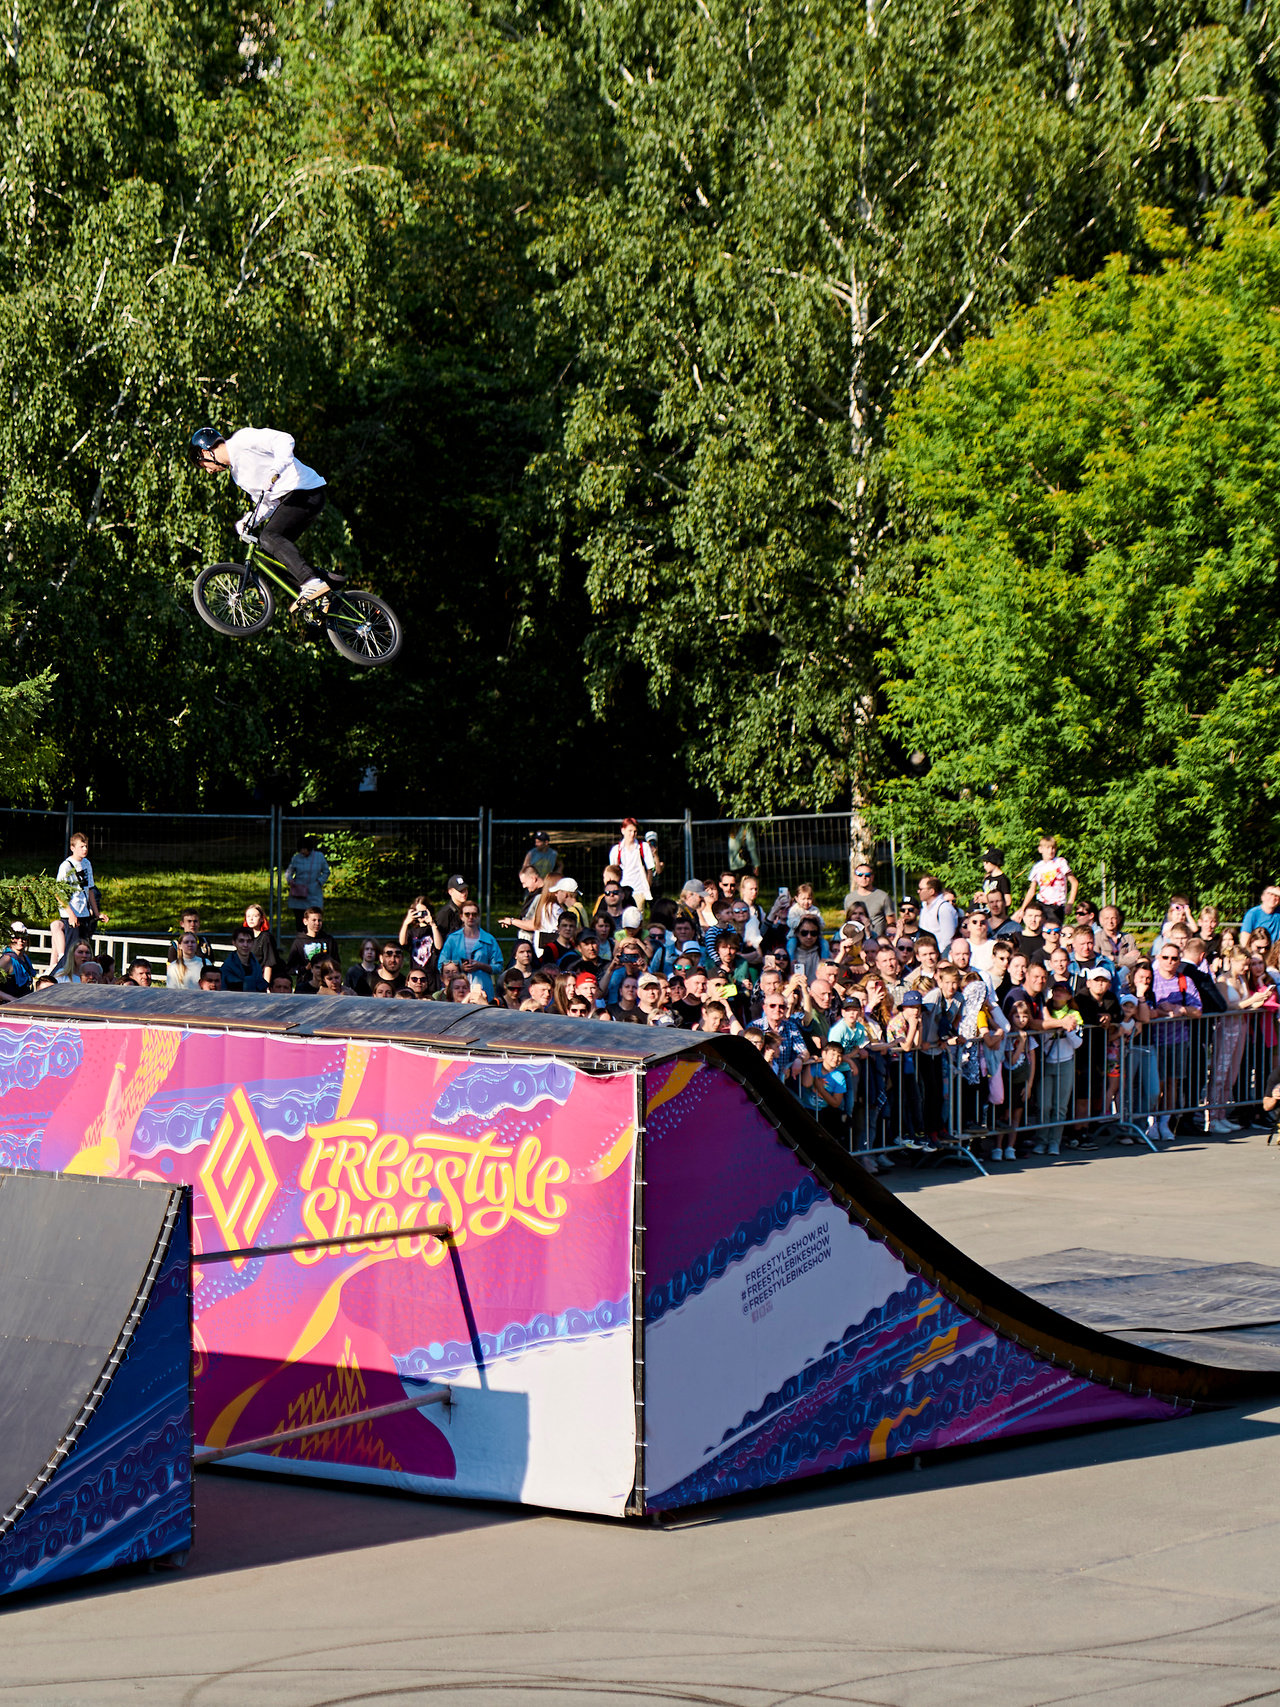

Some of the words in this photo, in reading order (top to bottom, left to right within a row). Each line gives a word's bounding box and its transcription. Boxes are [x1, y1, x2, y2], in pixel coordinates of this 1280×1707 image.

[741, 1235, 831, 1301] #FREESTYLEBIKESHOW
[742, 1247, 832, 1316] @FREESTYLEBIKESHOW
[745, 1221, 829, 1285] FREESTYLESHOW.RU
